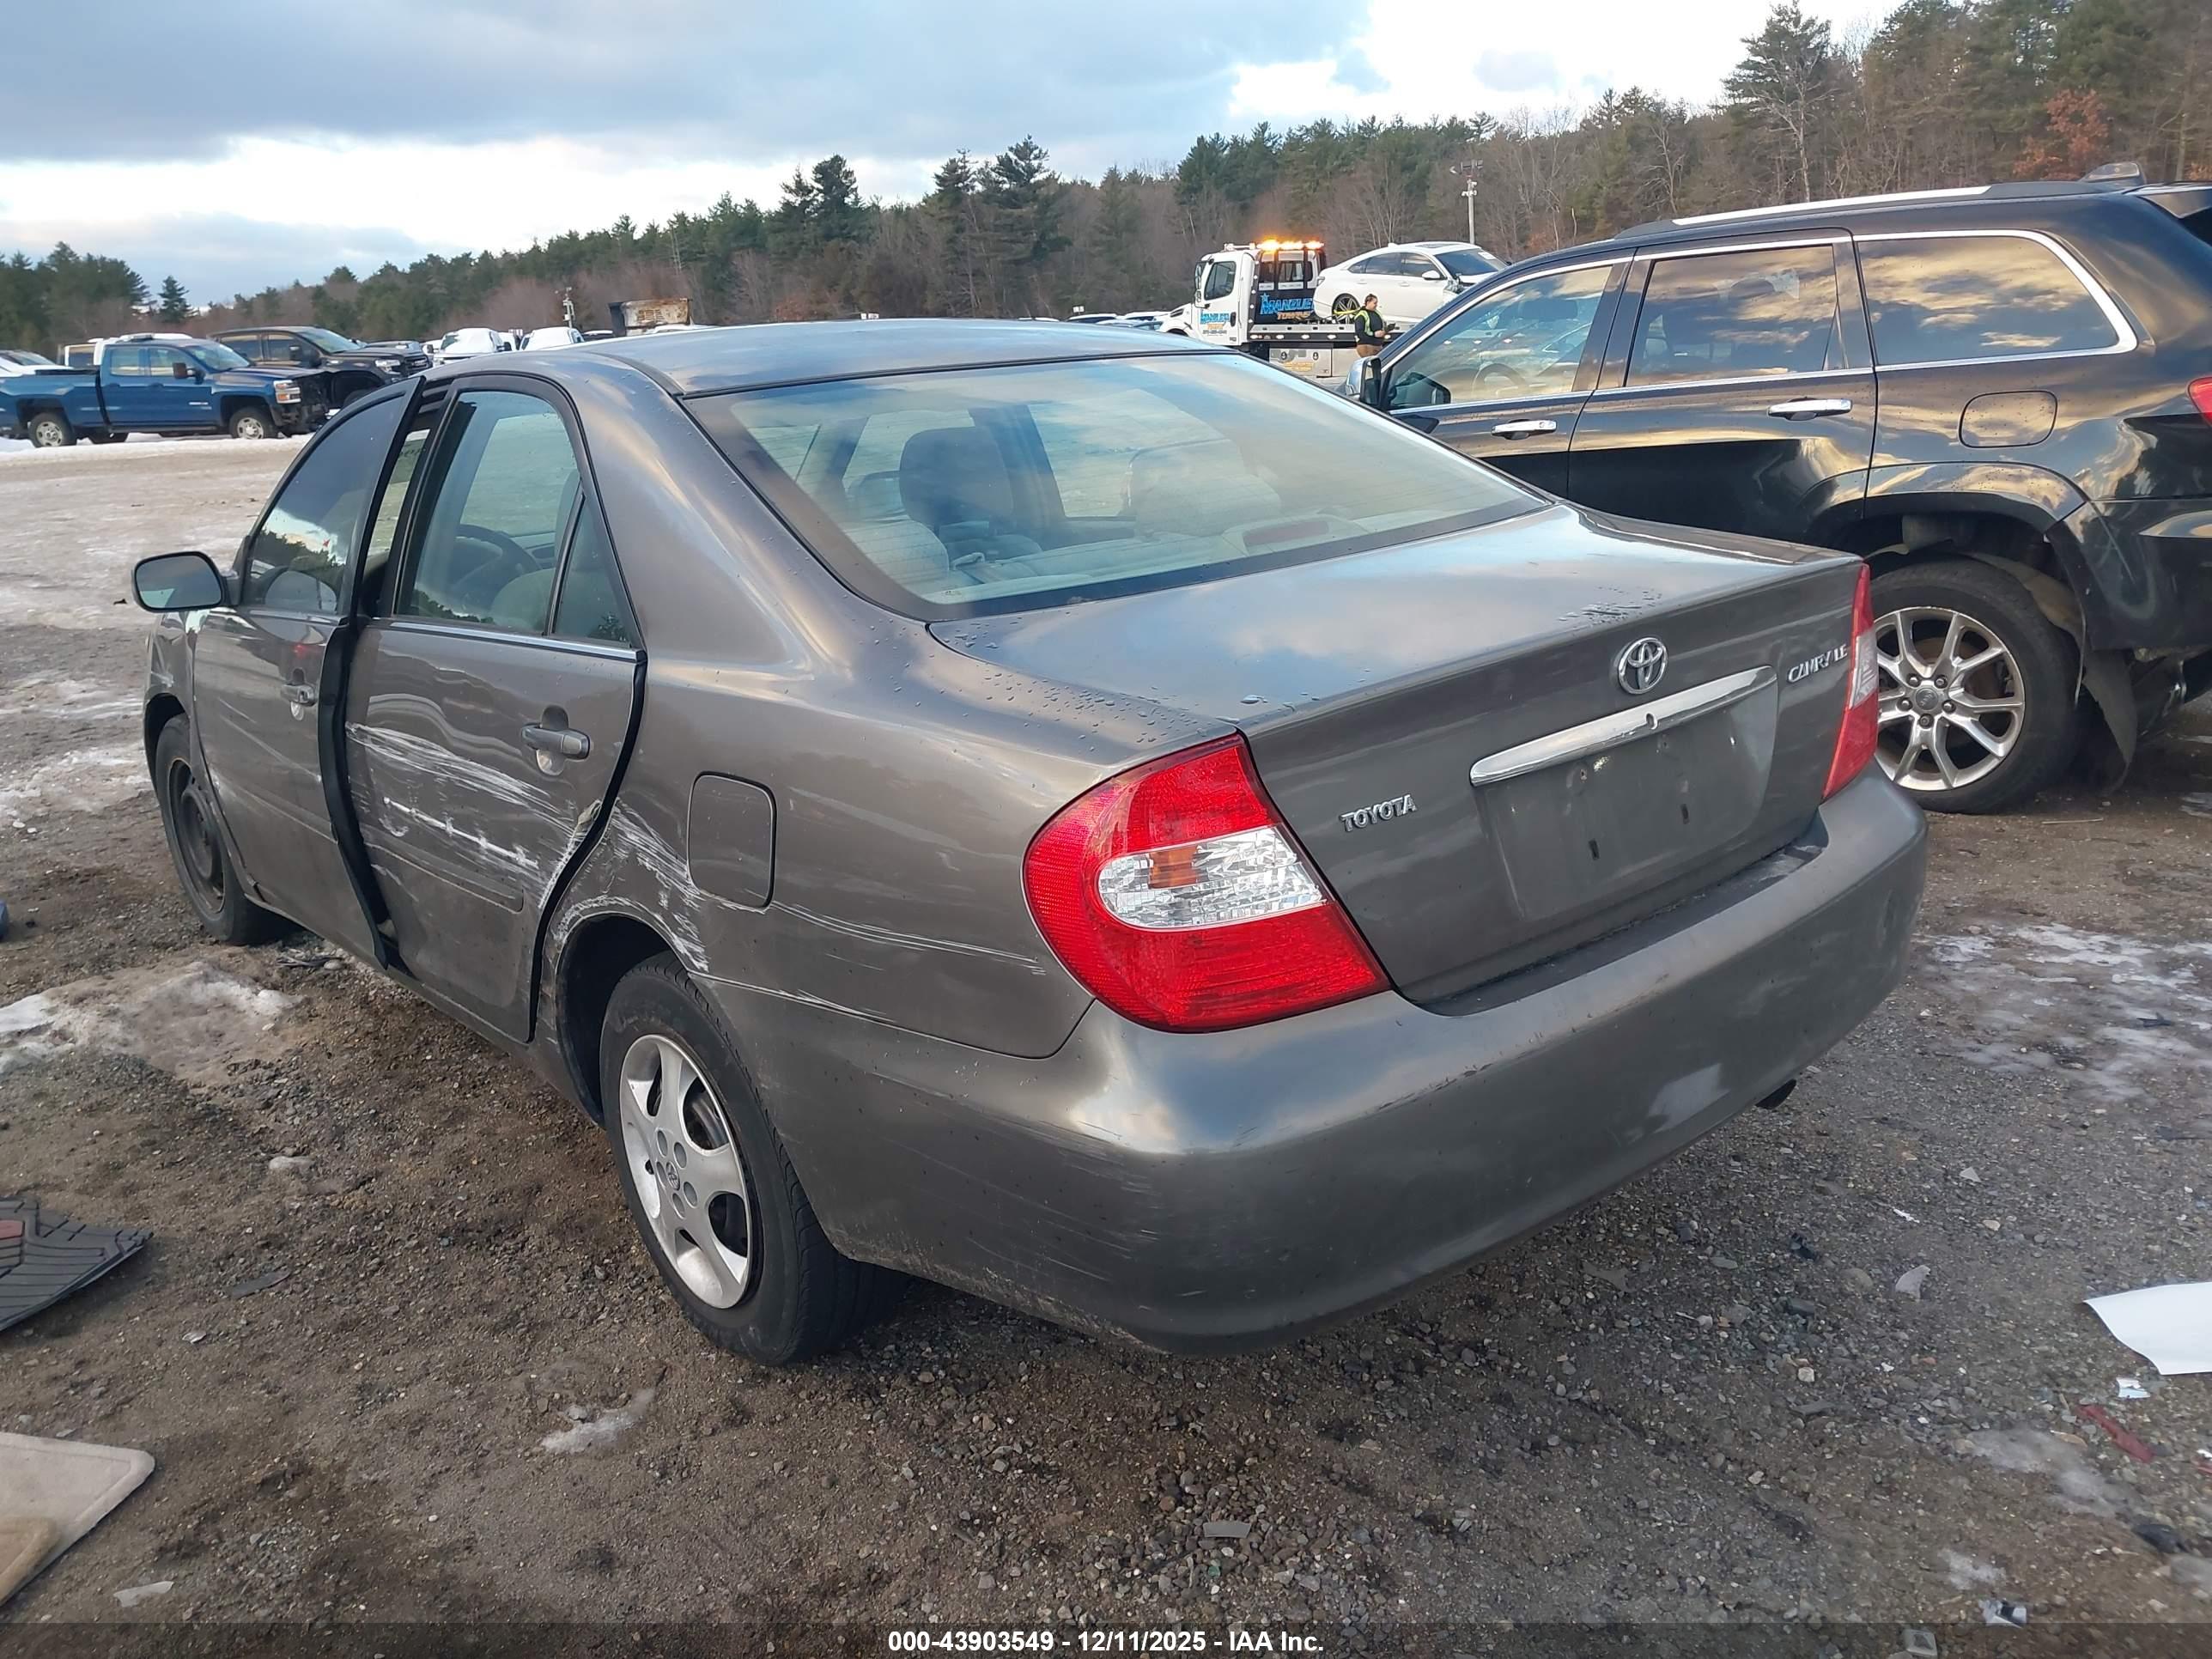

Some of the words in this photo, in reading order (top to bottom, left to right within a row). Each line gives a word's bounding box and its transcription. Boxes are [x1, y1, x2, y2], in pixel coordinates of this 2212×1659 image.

[1788, 650, 1832, 683] CAMRY
[1833, 644, 1848, 662] LE
[1340, 794, 1417, 832] TOYOTA
